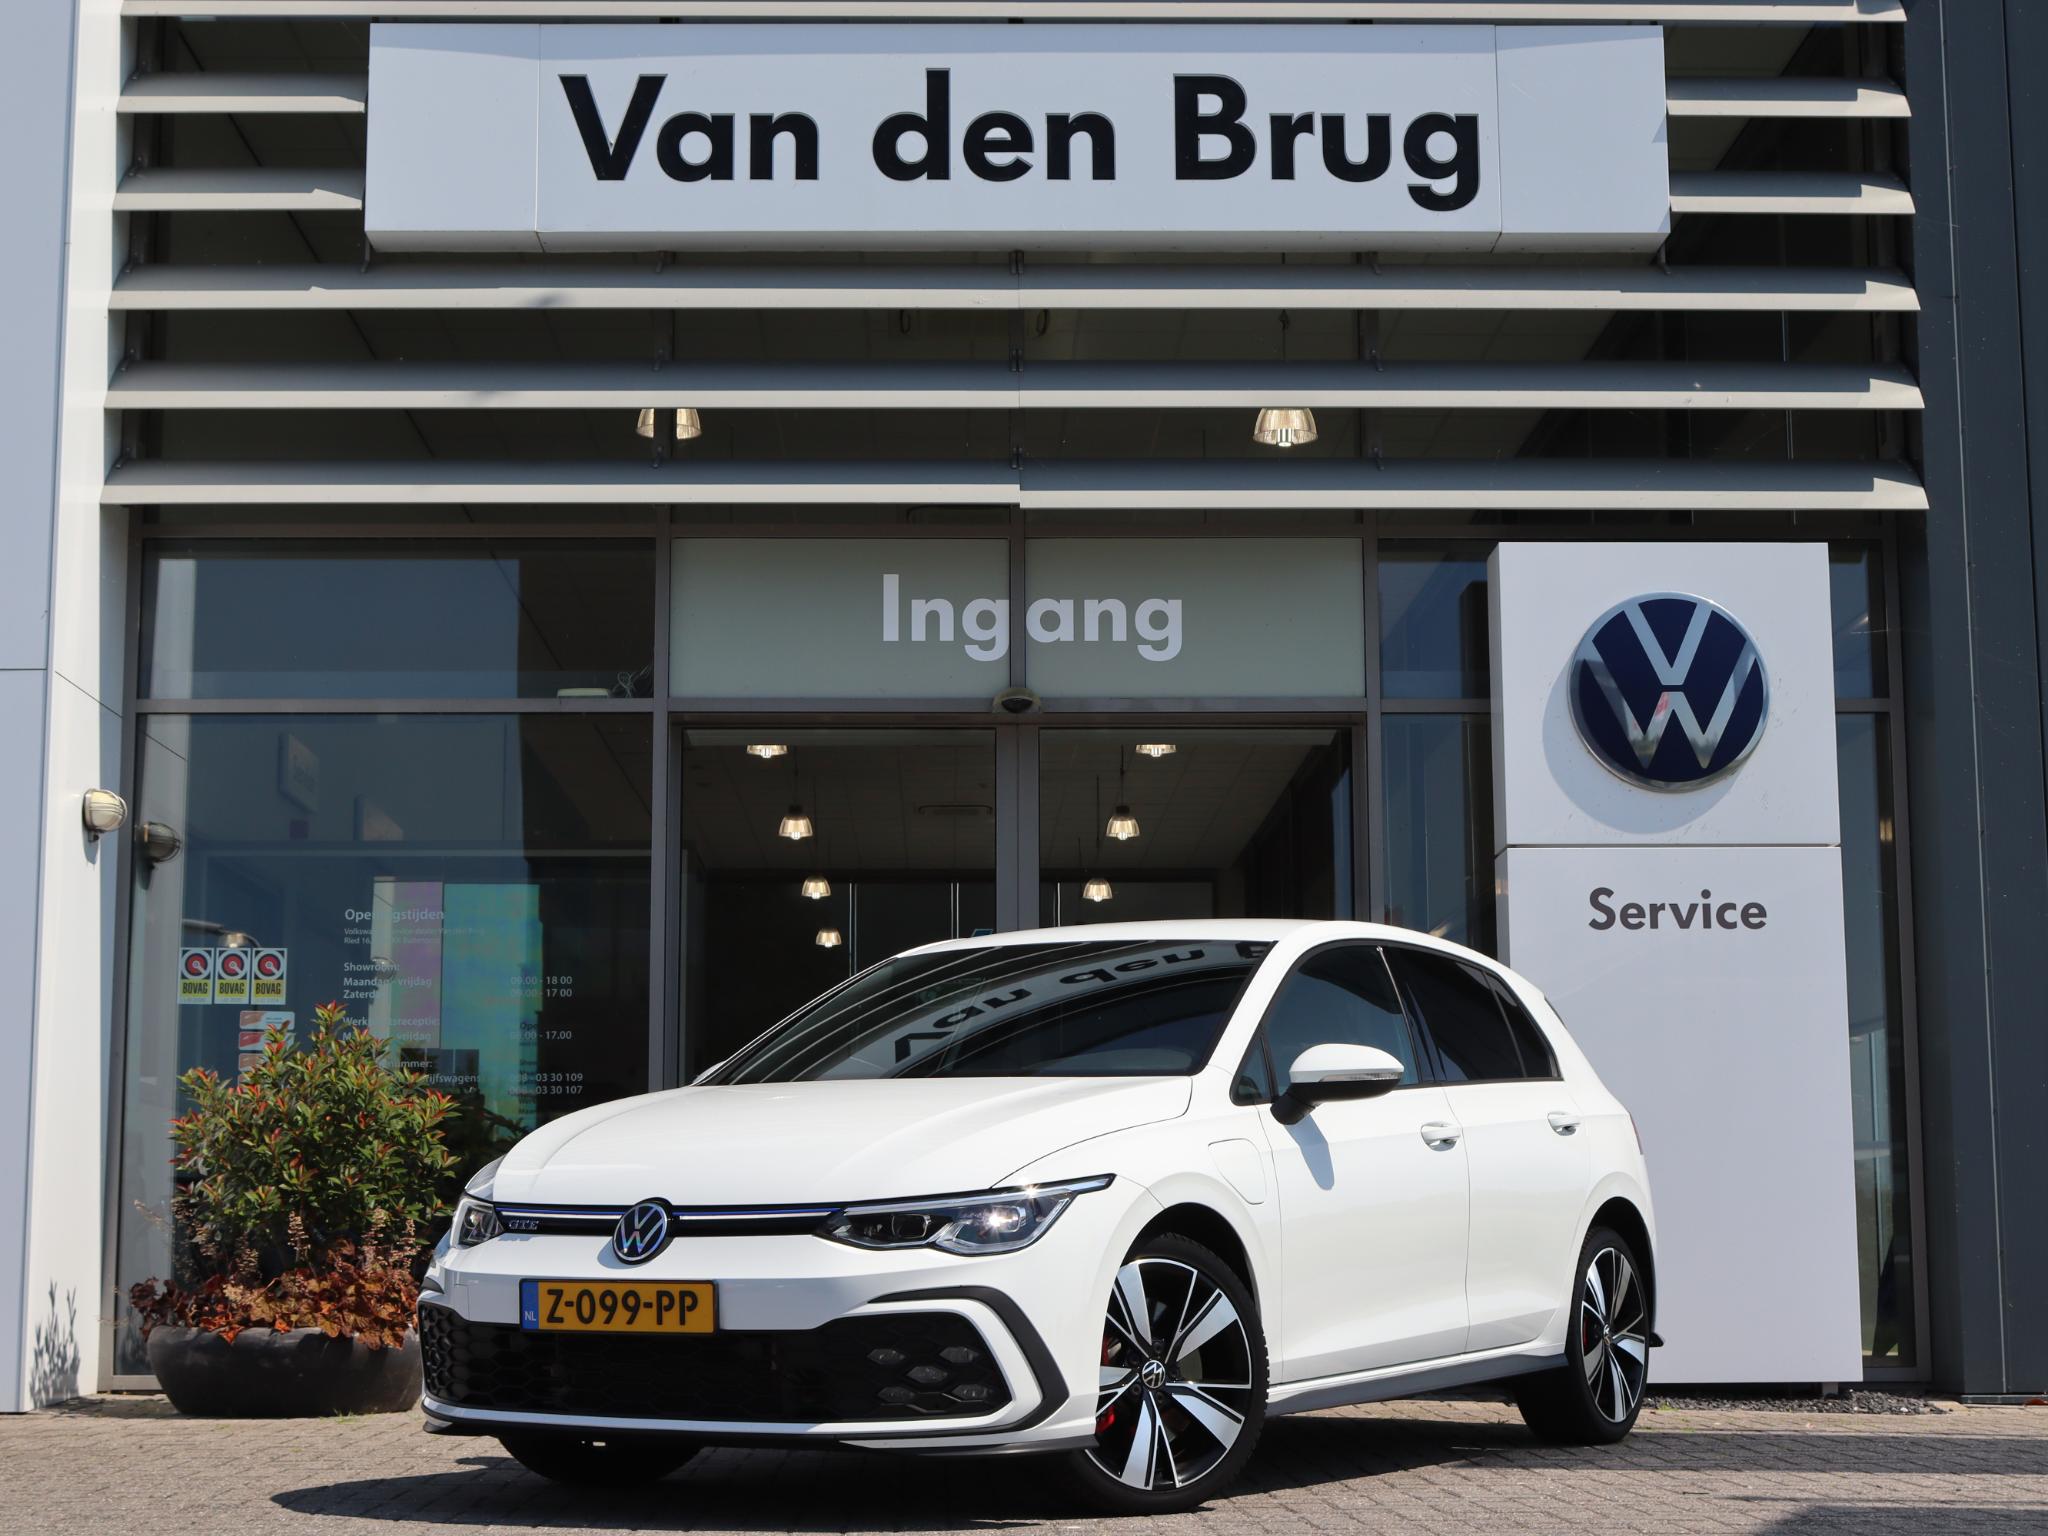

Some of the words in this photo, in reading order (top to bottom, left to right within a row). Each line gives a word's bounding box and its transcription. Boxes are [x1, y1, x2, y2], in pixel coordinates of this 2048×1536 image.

[558, 73, 819, 182] Van
[872, 67, 1116, 182] den
[1173, 73, 1480, 212] Brug
[882, 574, 1183, 662] Ingang
[344, 908, 444, 923] Opegstijden
[1588, 887, 1767, 931] Service
[182, 982, 208, 995] BOVAG
[219, 982, 245, 995] BOVAG
[255, 982, 281, 995] BOVAG
[524, 1311, 537, 1321] NL
[546, 1289, 698, 1325] Z-099-PP
